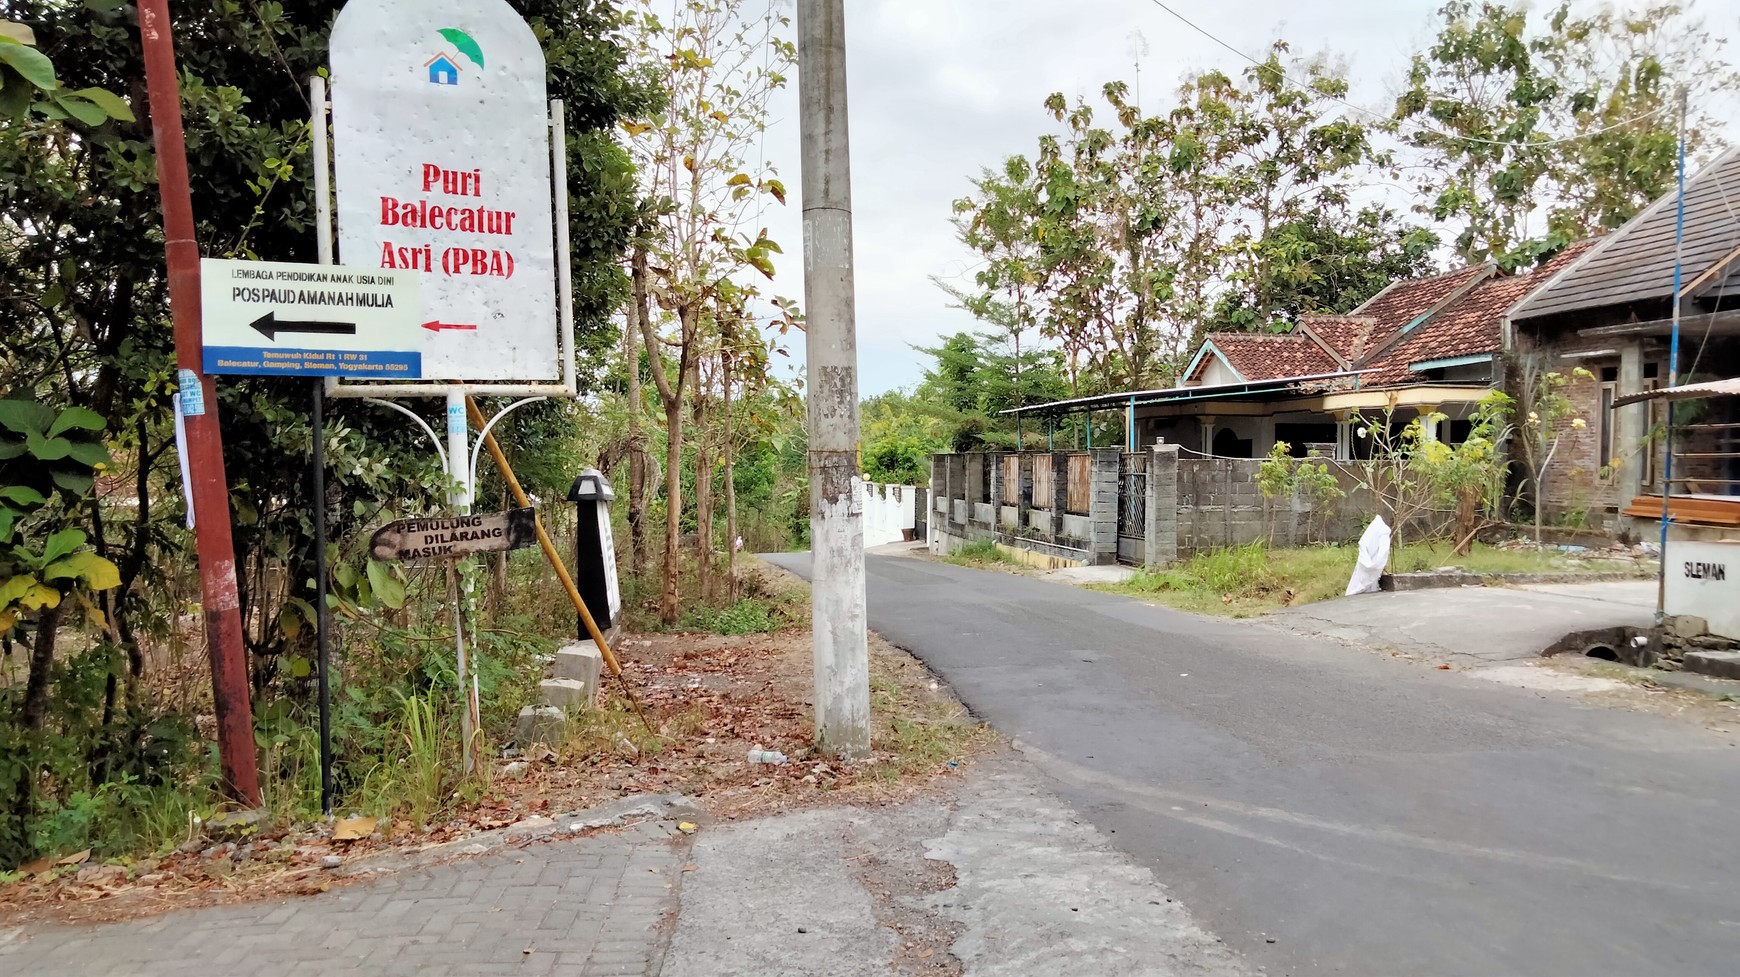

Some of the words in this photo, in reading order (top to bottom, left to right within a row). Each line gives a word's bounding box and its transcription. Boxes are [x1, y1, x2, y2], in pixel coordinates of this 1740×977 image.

[422, 163, 481, 197] Puri
[380, 196, 515, 235] Balecatur
[380, 241, 432, 272] Asri
[442, 248, 514, 280] (PBA)
[231, 269, 274, 281] LEMBAGA
[276, 271, 328, 283] PENDIDIKAN
[330, 273, 354, 284] ANAK
[356, 275, 376, 285] USIA
[377, 276, 394, 286] DINI
[232, 287, 260, 303] POS
[262, 288, 296, 304] PAUD
[298, 290, 354, 307] AMANAH
[356, 293, 394, 308] MULIA
[344, 353, 358, 361] RW
[339, 362, 384, 371] Yogyakarta
[396, 516, 482, 534] PEMULUNG
[424, 527, 502, 545] DILARANG
[397, 545, 454, 561] MASUK
[1684, 561, 1725, 581] SLEMAN
